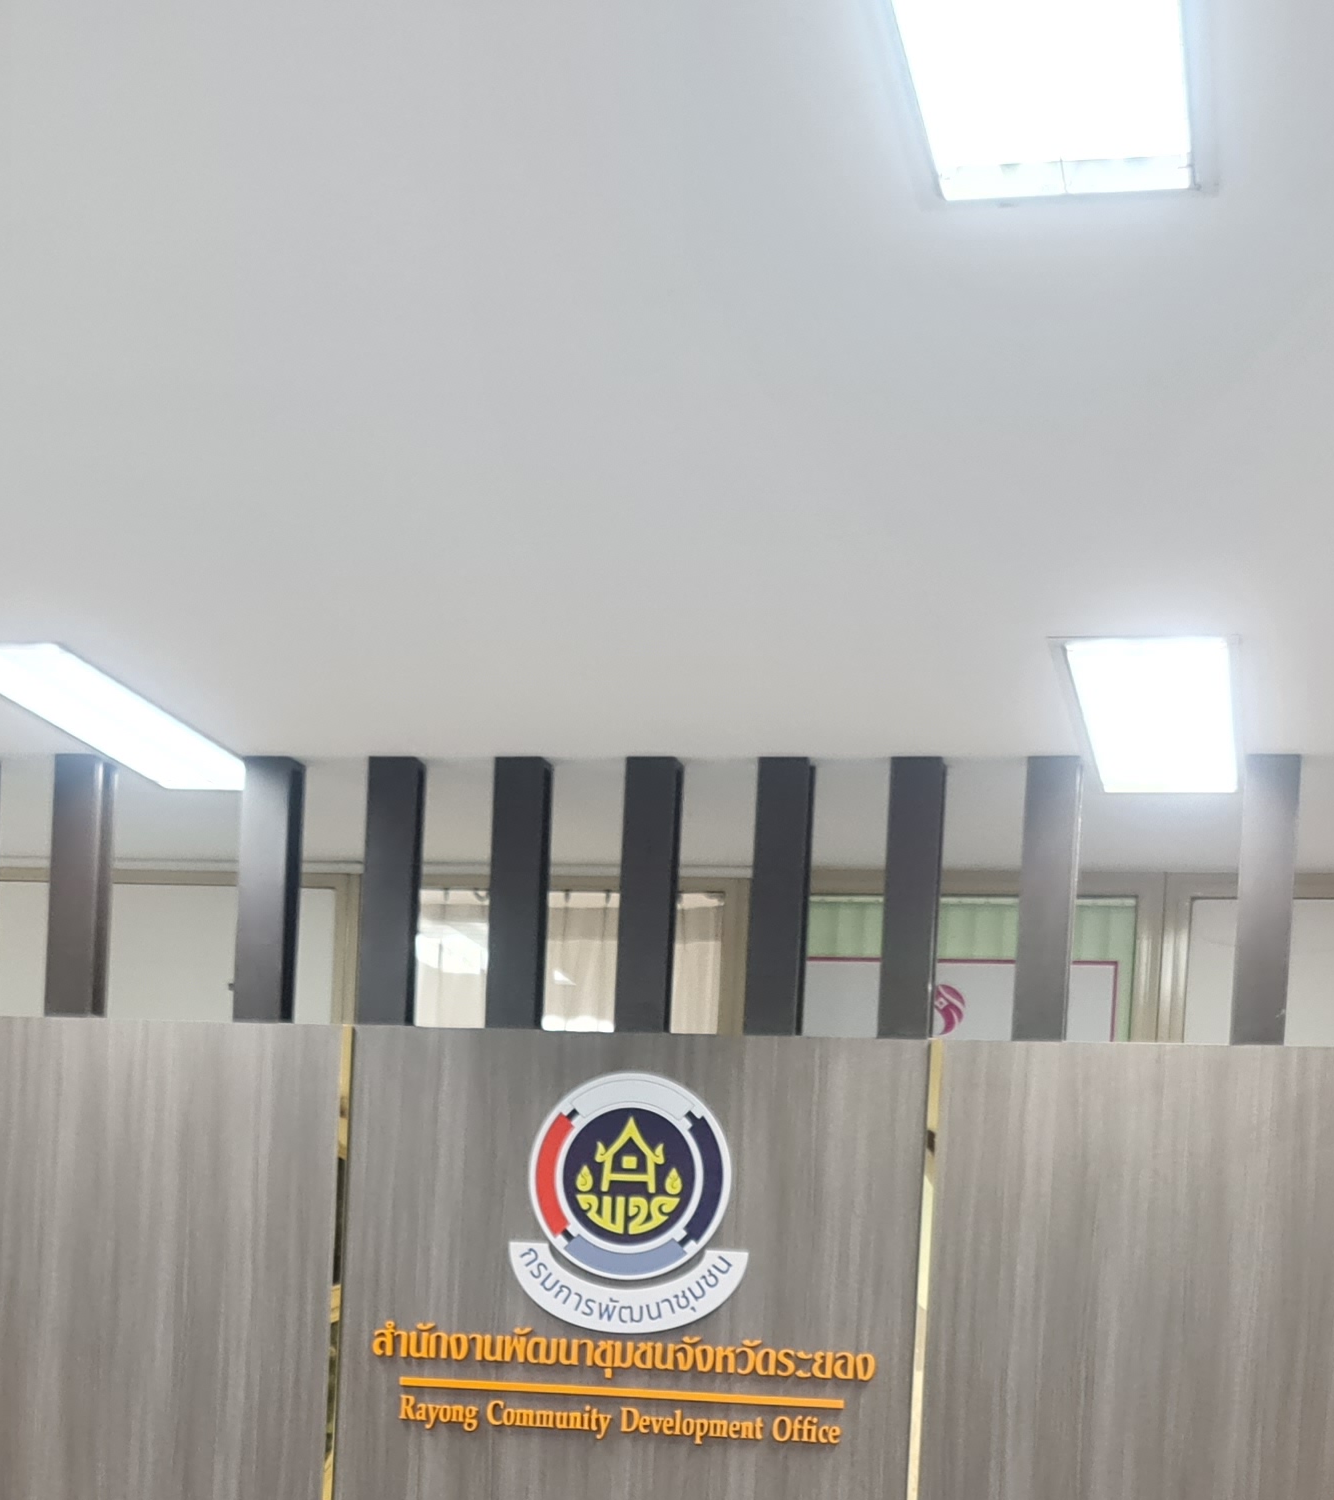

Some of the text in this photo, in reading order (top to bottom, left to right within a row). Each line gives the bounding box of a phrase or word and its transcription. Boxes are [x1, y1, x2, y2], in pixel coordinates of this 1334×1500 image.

[519, 1246, 733, 1324] กรมการพัฒนาชุมชน
[372, 1320, 876, 1382] สำนักงานพัฒนาชุมชนจังหวัดระยอง
[399, 1394, 842, 1445] Rayong Community Development Office
